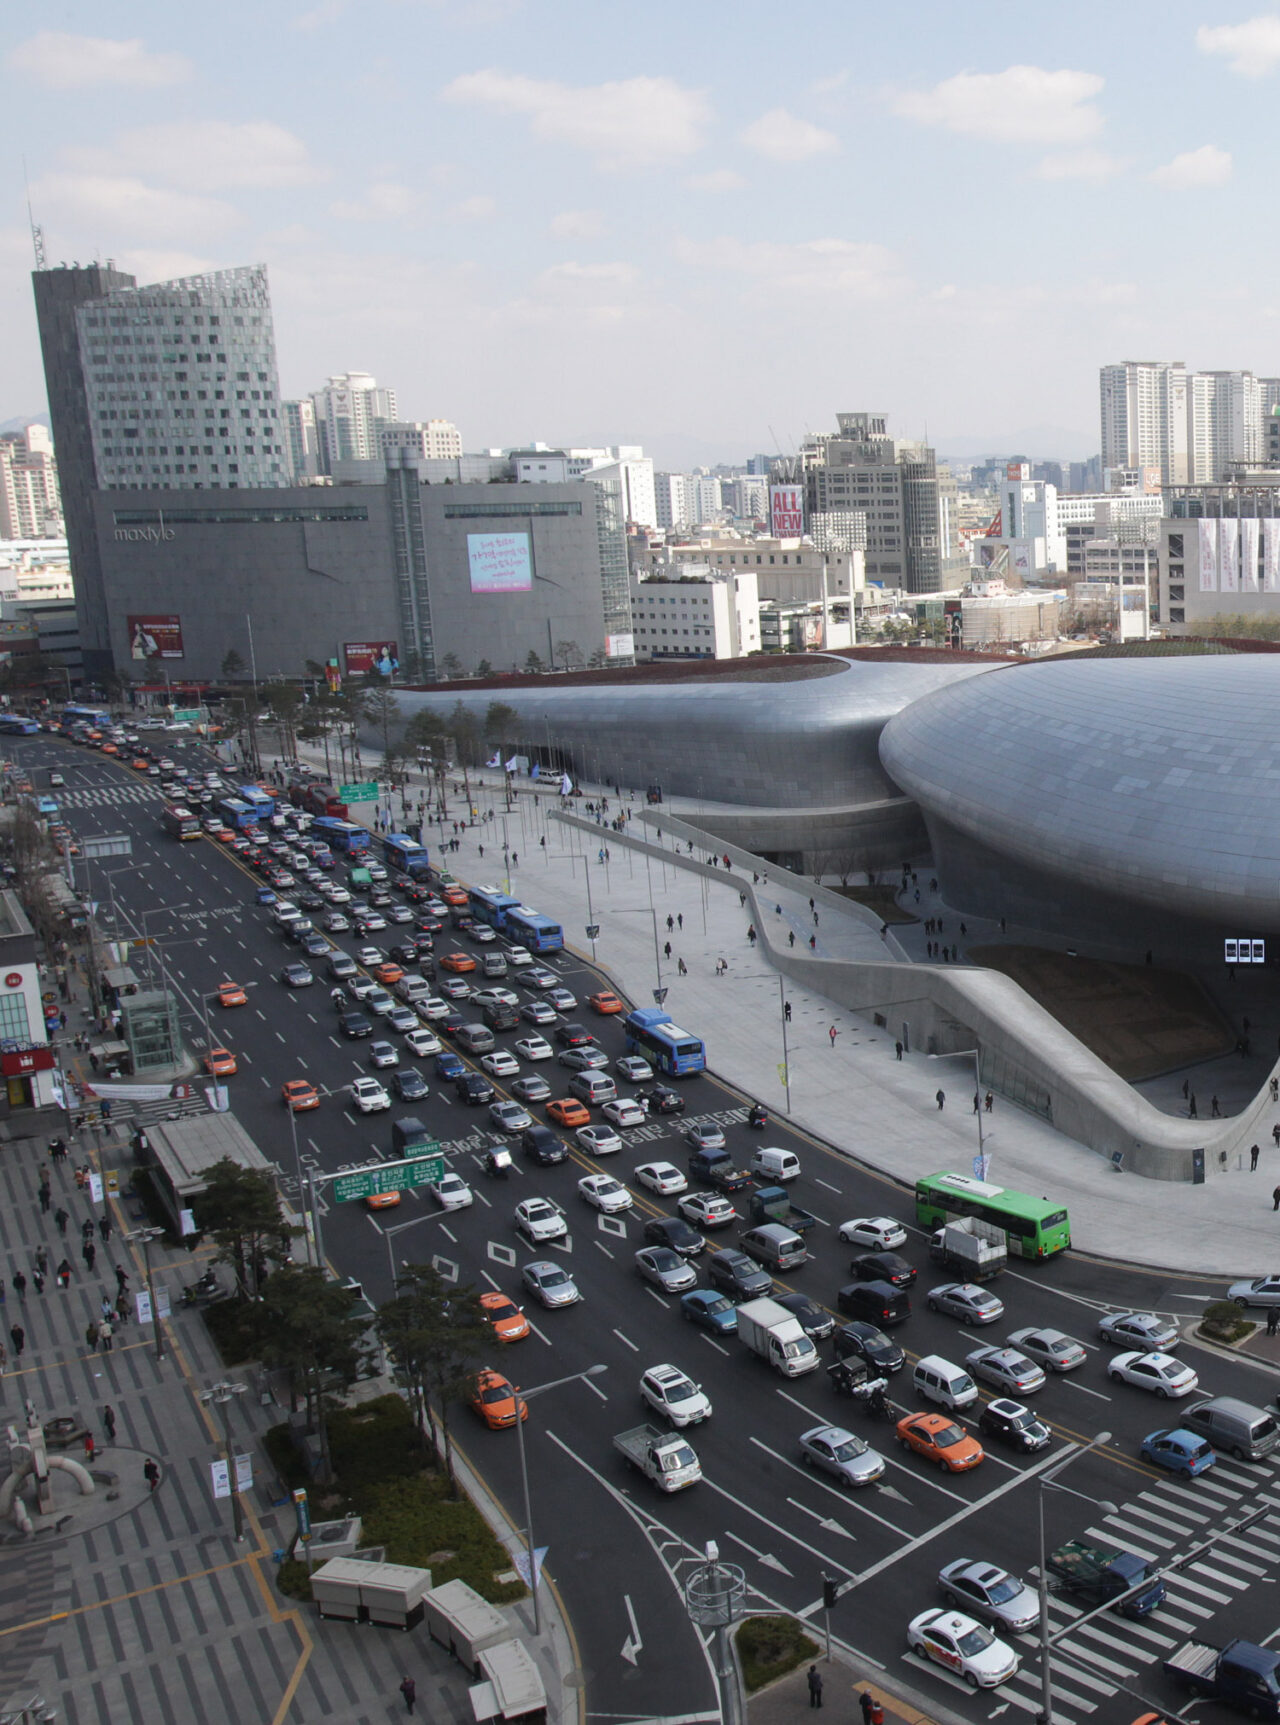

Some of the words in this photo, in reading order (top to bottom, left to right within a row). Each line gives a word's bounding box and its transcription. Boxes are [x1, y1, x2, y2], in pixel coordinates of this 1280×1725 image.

[773, 492, 801, 513] ALL
[773, 513, 801, 529] NEW
[621, 1124, 671, 1144] 동대문
